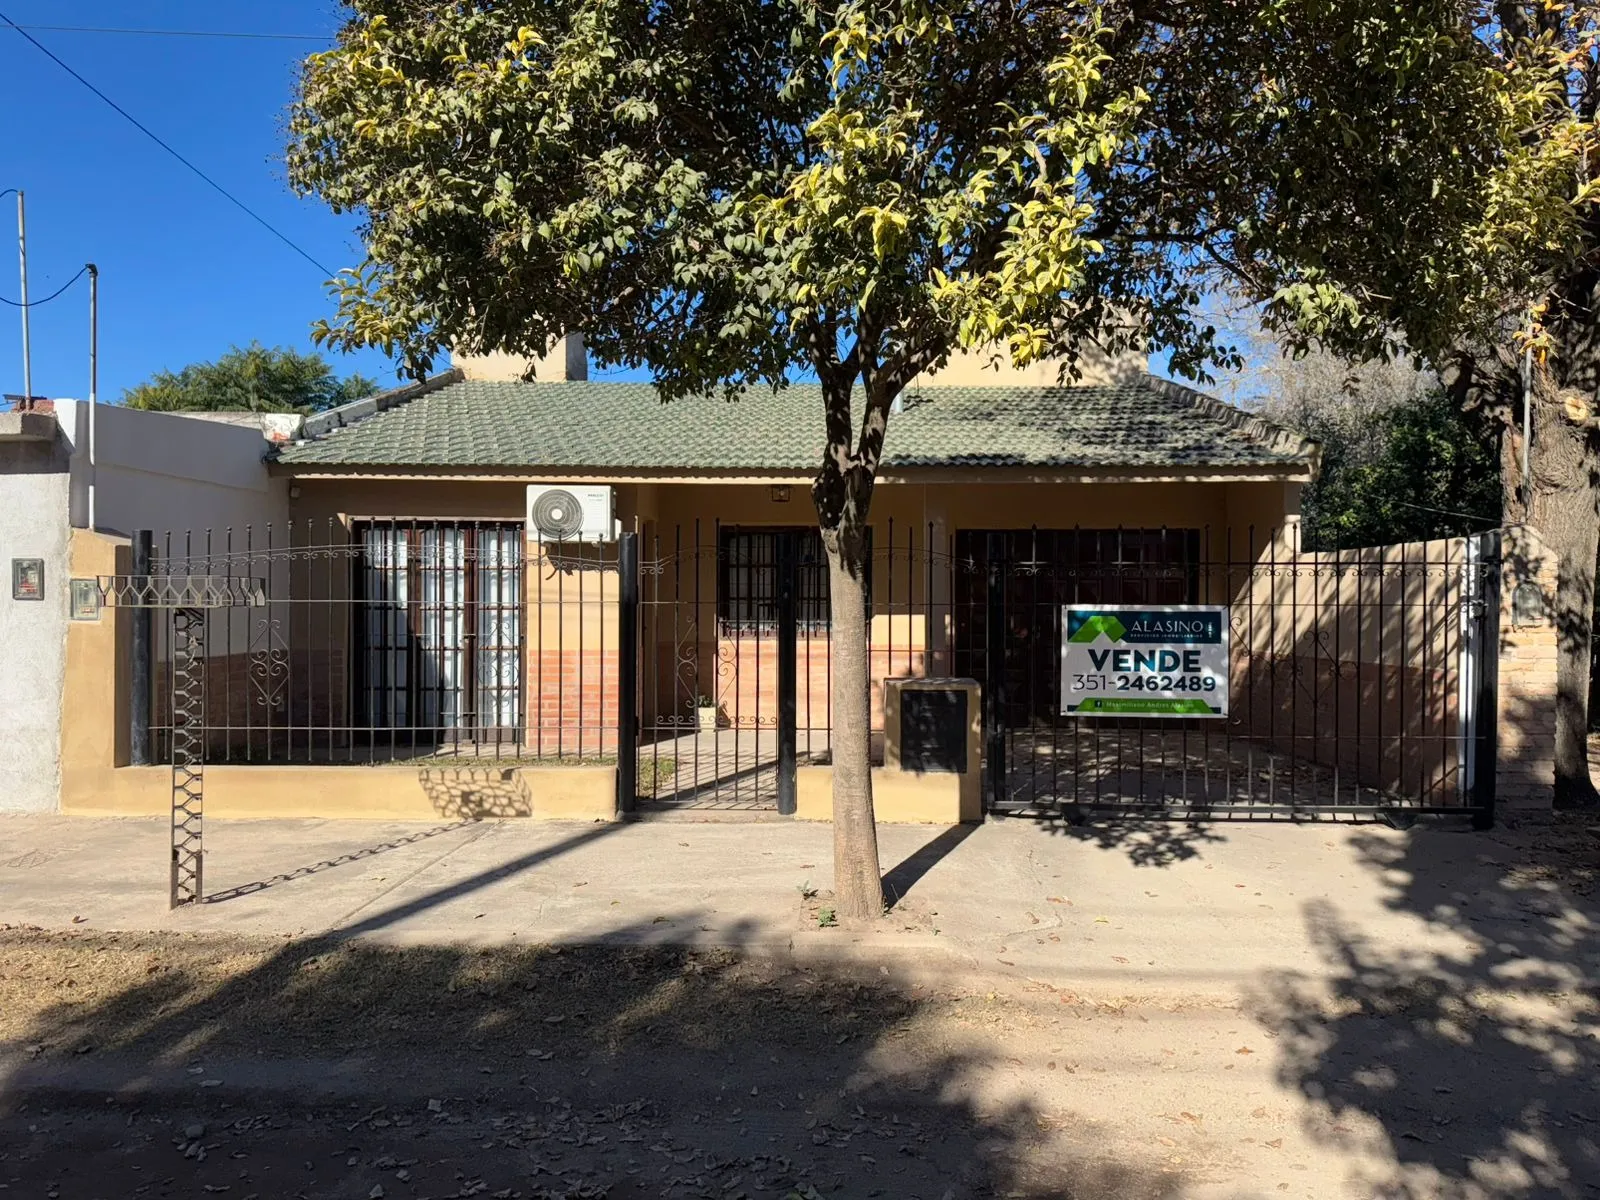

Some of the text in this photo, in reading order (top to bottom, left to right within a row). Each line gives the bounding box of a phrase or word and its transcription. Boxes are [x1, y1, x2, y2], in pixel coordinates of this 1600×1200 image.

[1131, 620, 1204, 633] ALASINO
[1087, 649, 1202, 673] VENDE
[1072, 674, 1216, 692] 351-2462489
